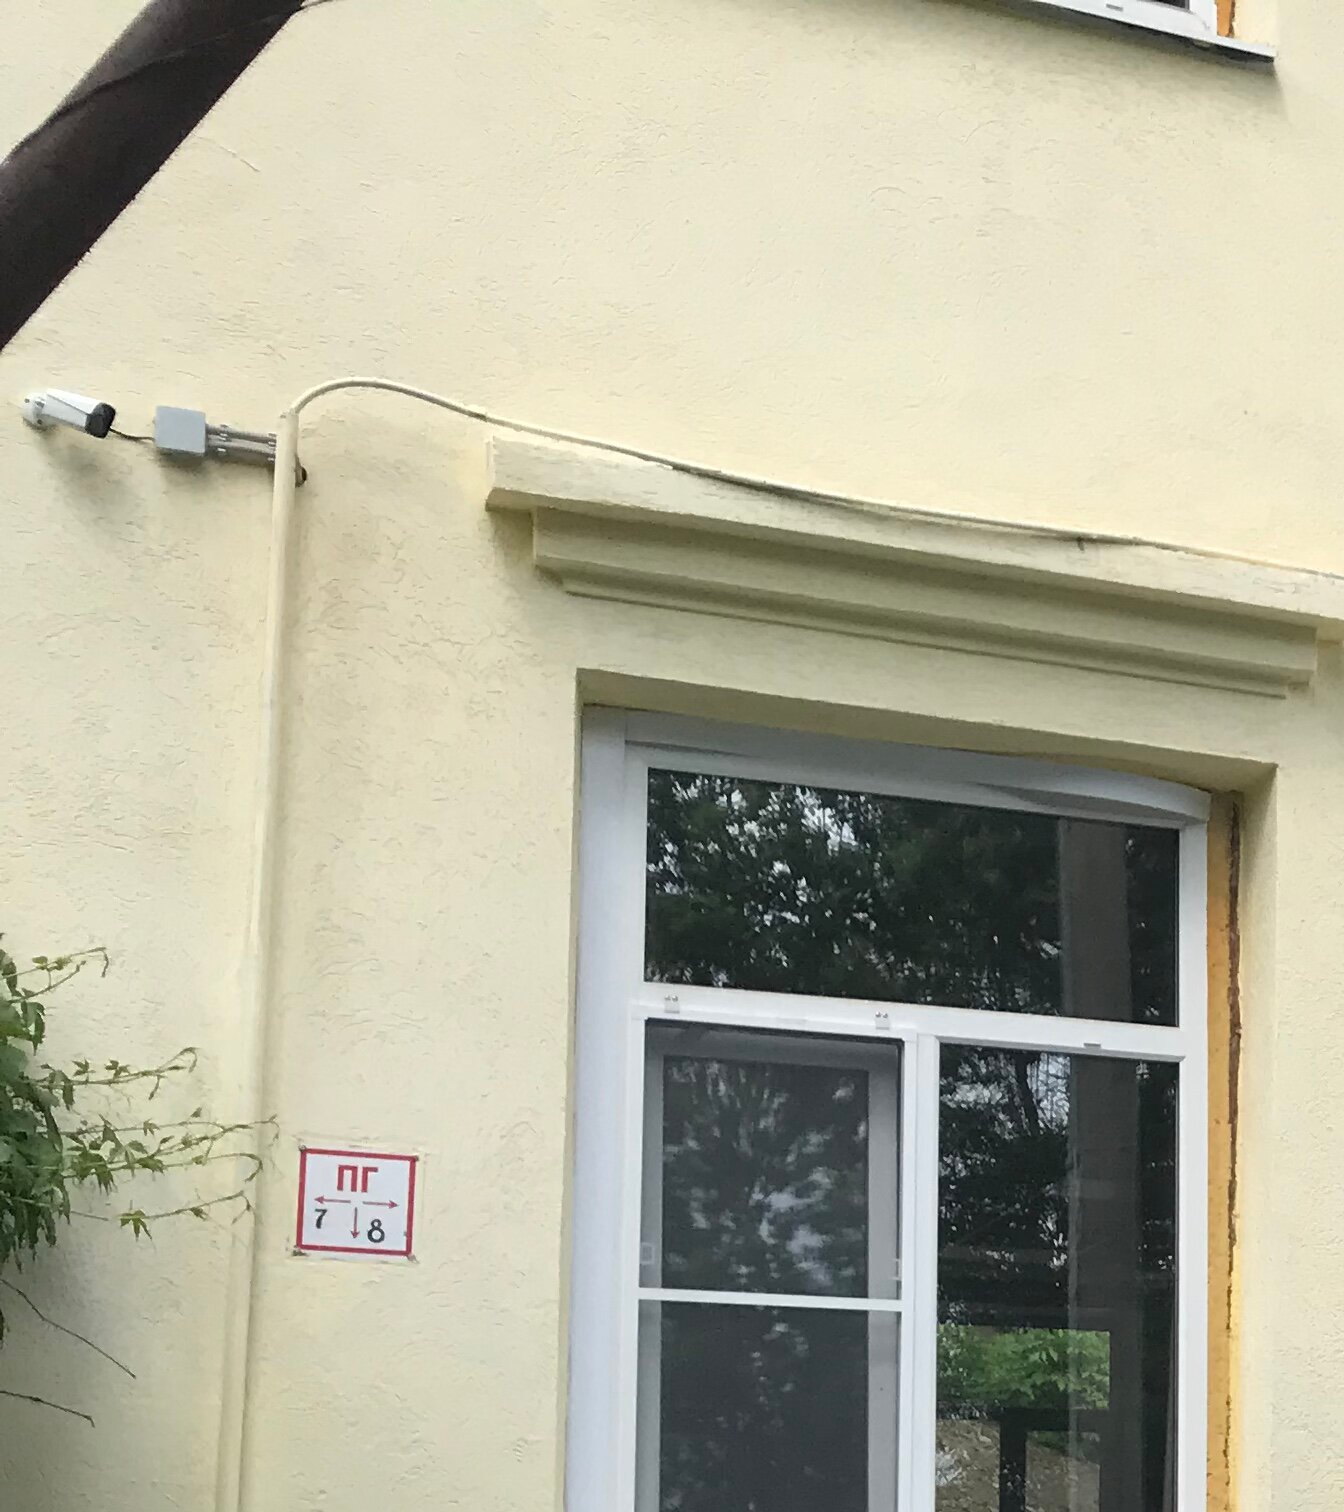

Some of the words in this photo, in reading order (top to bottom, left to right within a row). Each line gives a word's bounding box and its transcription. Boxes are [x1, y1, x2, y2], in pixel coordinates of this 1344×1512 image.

[336, 1164, 379, 1193] ПГ
[314, 1208, 327, 1229] 7
[367, 1218, 385, 1243] 8
